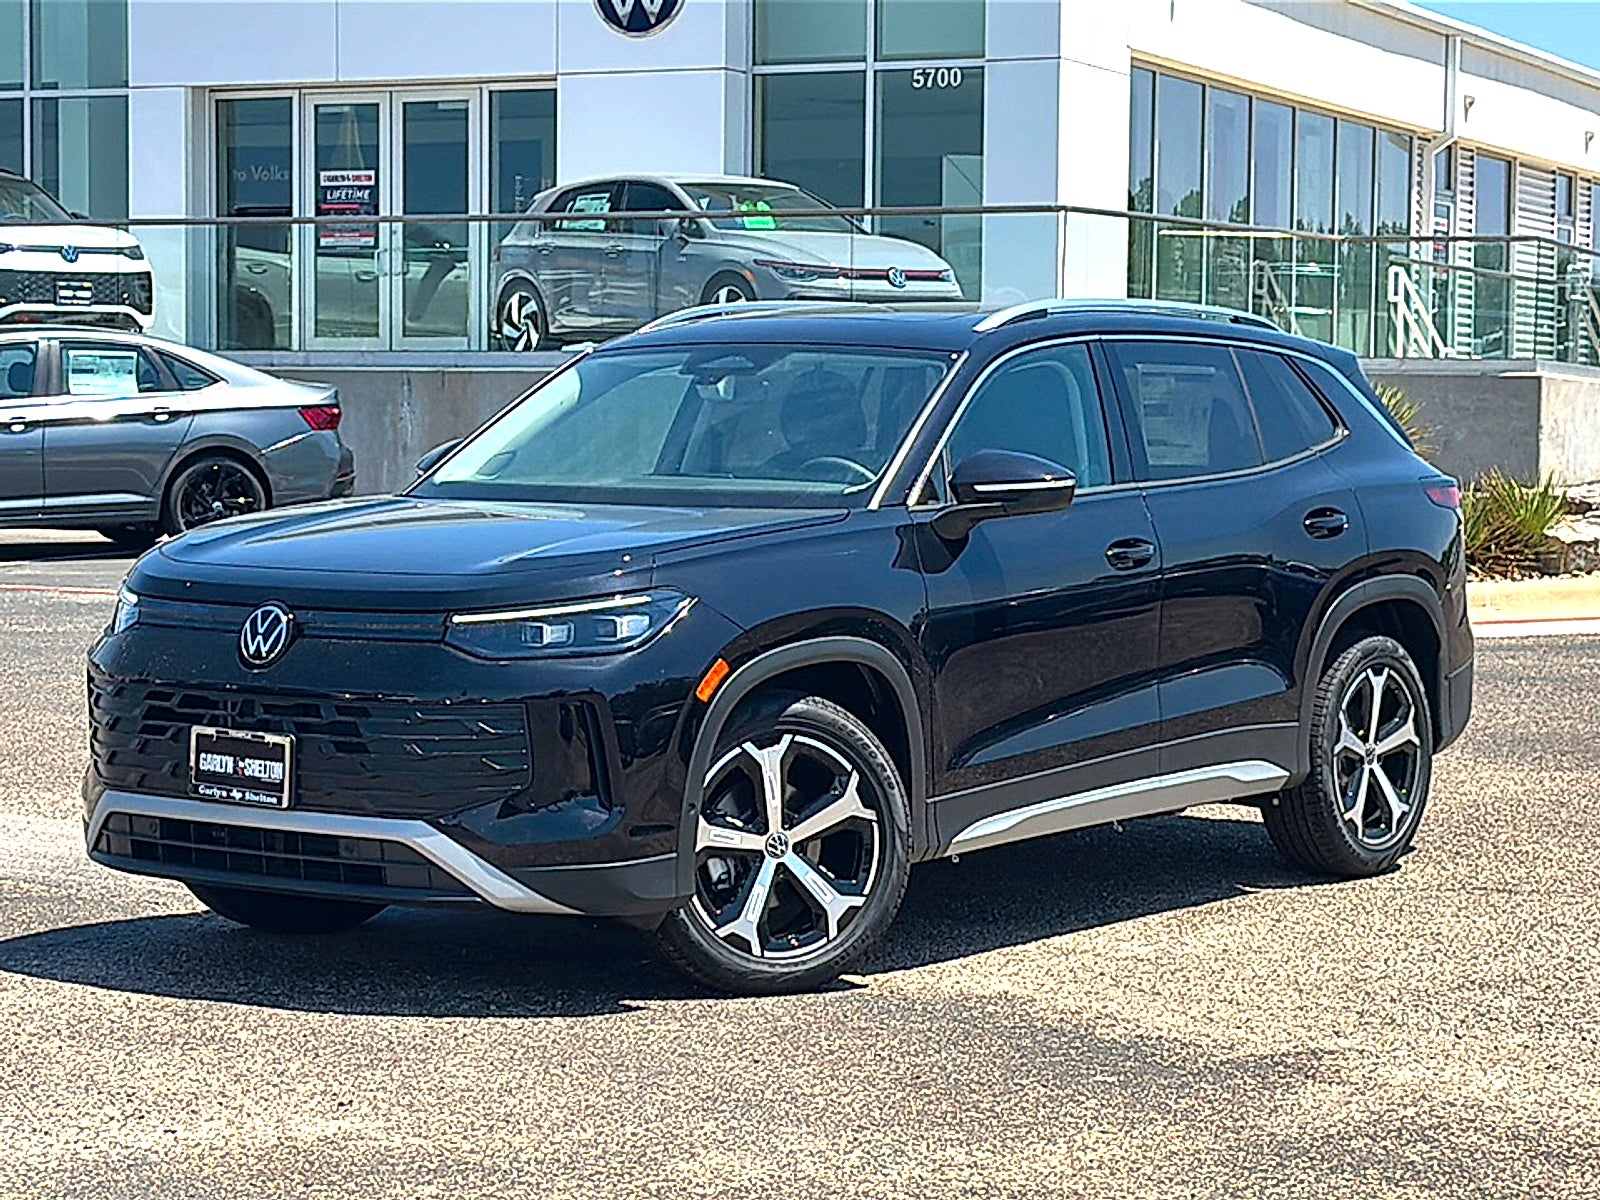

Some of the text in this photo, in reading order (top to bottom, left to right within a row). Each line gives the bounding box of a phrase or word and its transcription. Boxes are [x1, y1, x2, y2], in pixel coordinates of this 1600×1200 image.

[912, 68, 961, 88] 5700
[327, 189, 371, 200] LIFETIME
[199, 753, 283, 780] GARLYN SHELTON
